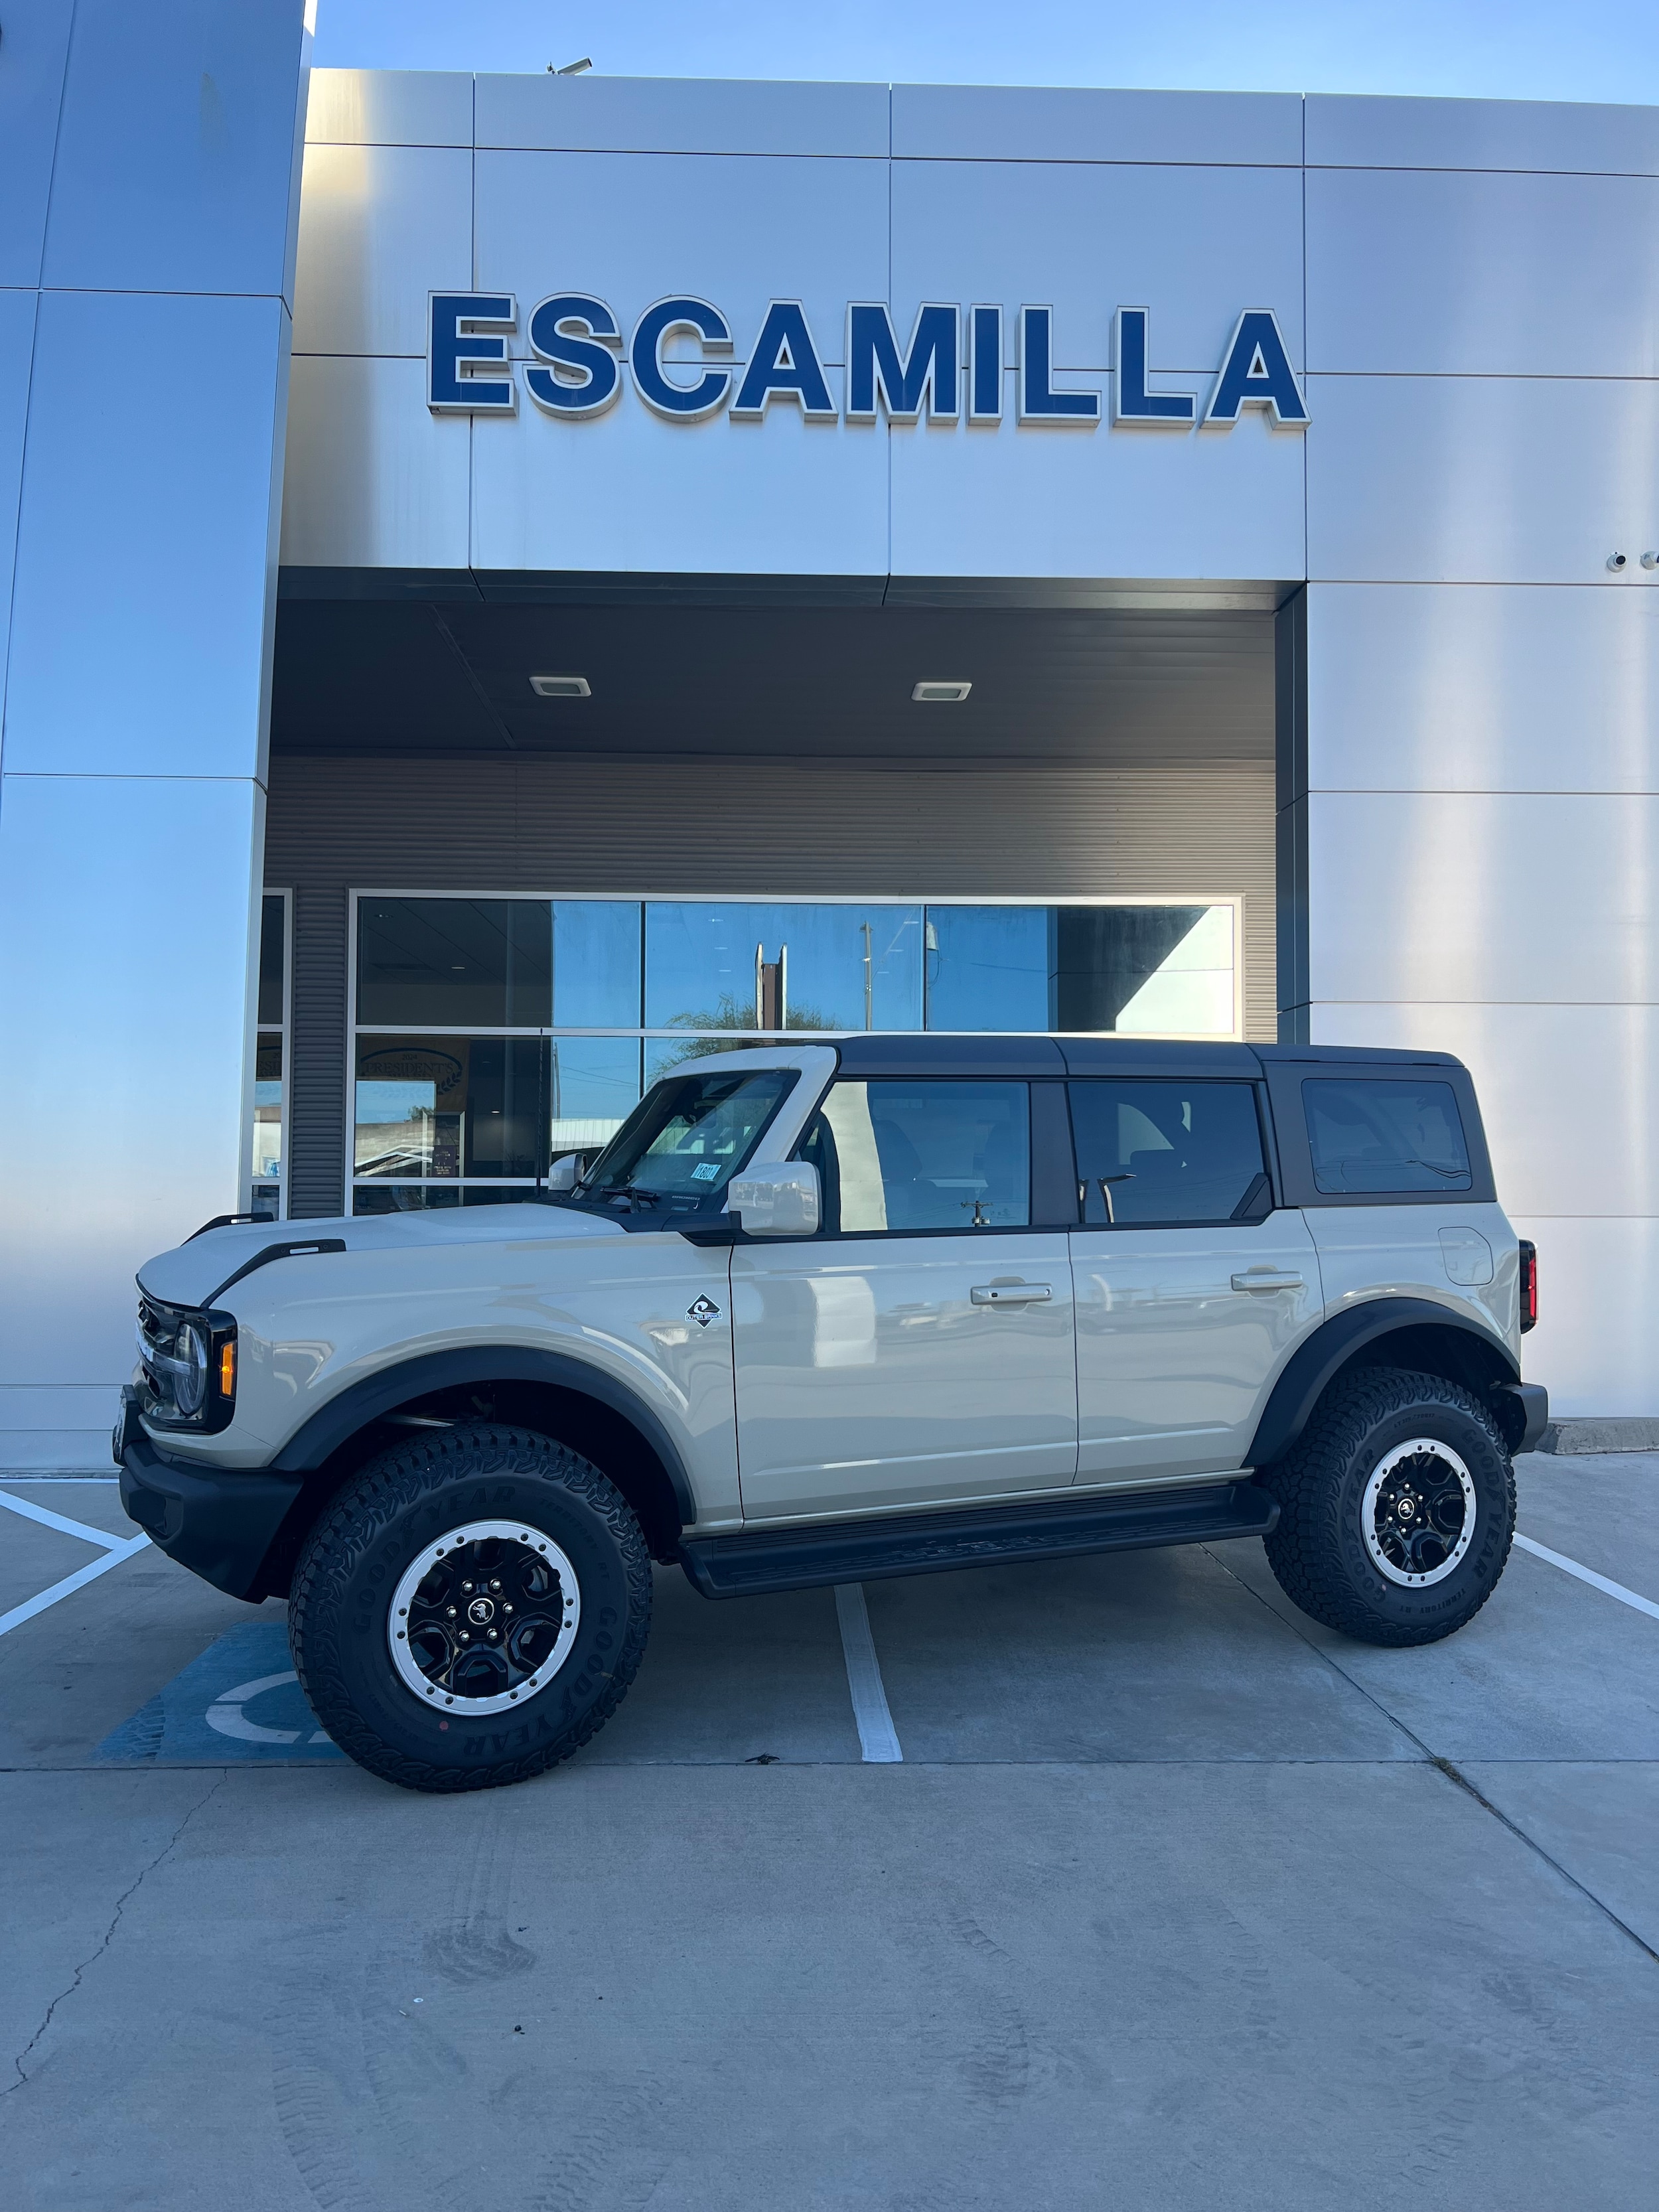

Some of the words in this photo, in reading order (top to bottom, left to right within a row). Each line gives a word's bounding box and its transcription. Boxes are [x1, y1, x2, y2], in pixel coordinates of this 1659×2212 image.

[428, 291, 1313, 431] ESCAMILLA
[365, 1062, 454, 1074] PRESIDENT'S
[352, 1486, 516, 1635] GOODYEAR
[539, 1498, 600, 1550] TERRITORY
[597, 1562, 611, 1581] RT
[1341, 1449, 1386, 1602] GOODYEAR
[1463, 1429, 1506, 1579] GOODYEAR
[1419, 1587, 1467, 1615] TERRITORY
[461, 1605, 618, 1756] GOODYEAR
